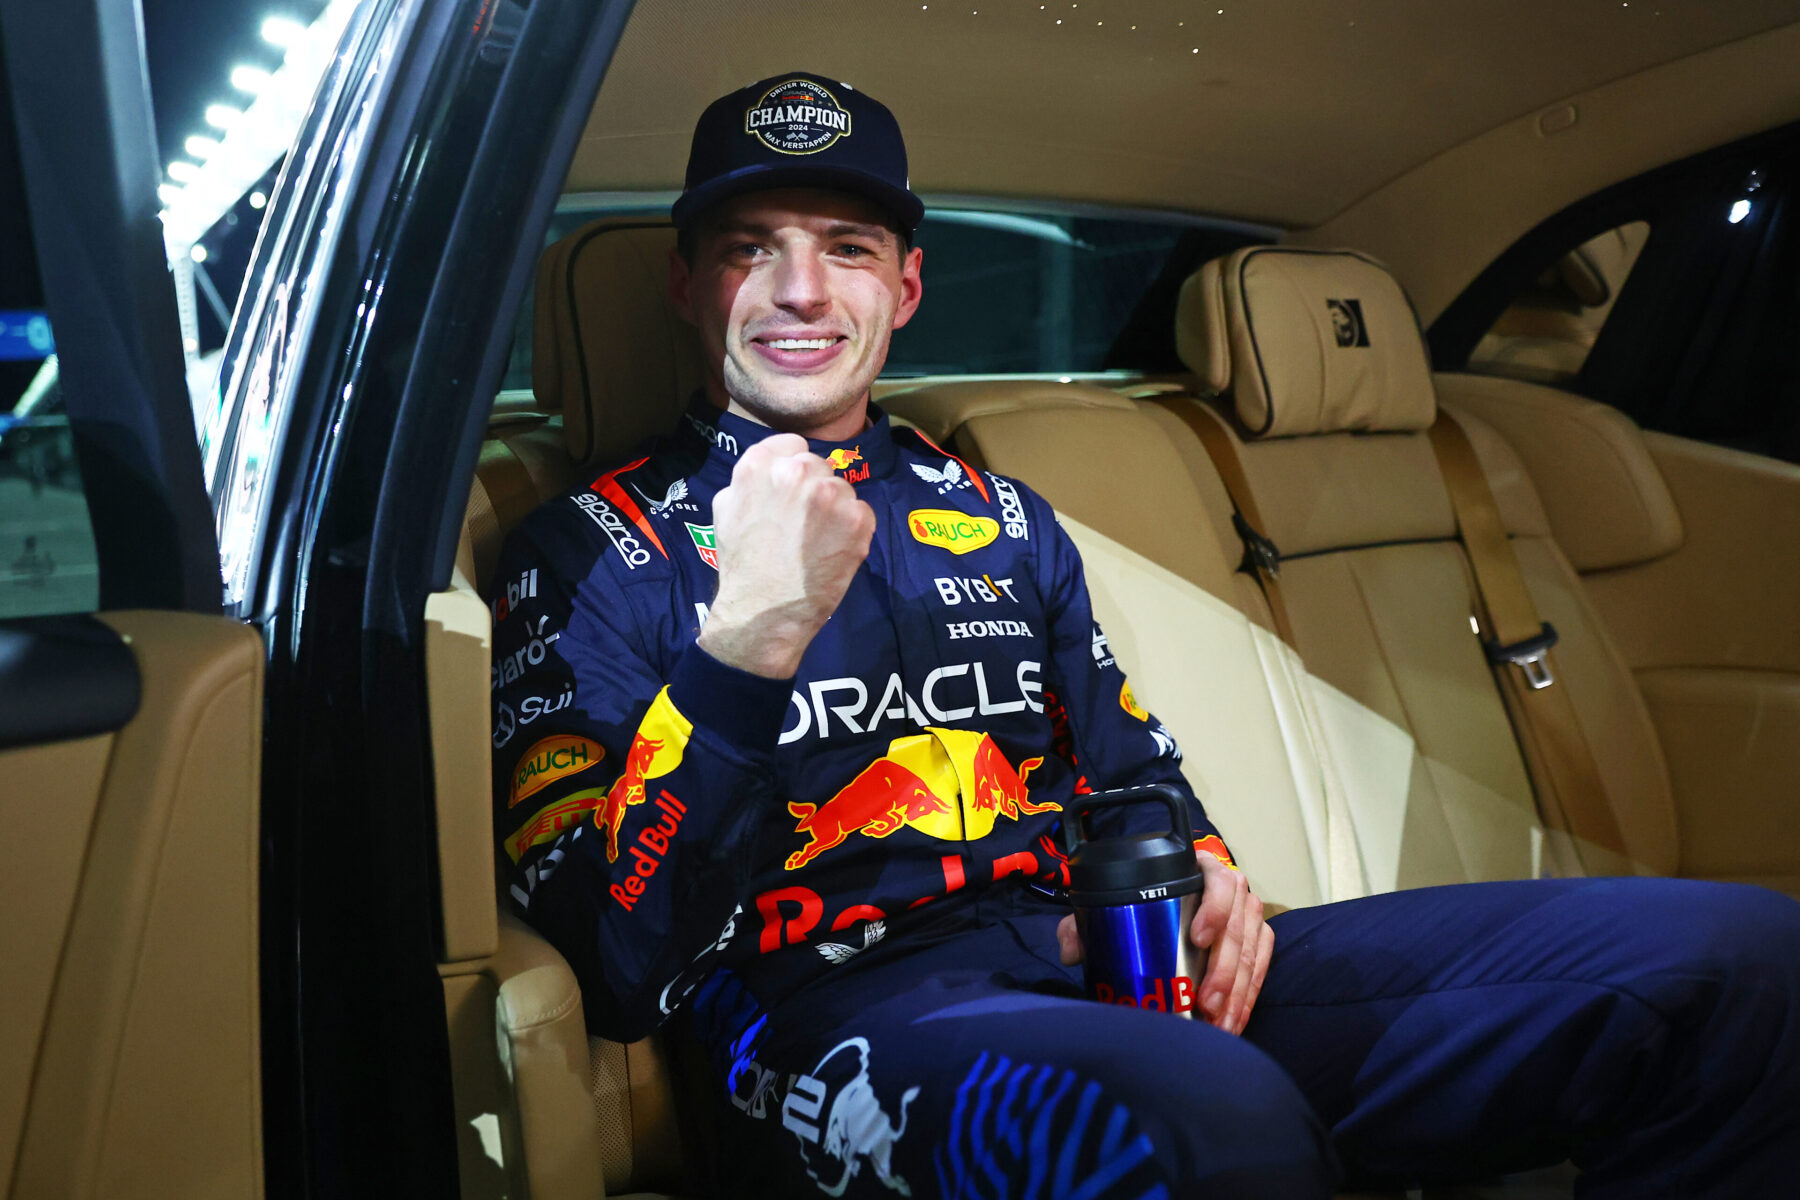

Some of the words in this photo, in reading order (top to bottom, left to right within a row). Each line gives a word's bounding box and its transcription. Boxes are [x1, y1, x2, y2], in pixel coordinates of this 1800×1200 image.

[769, 82, 798, 98] DRIVER
[800, 82, 828, 99] WORLD
[749, 105, 847, 131] CHAMPION
[764, 131, 781, 145] MAX
[782, 131, 832, 149] VERSTAPPEN
[649, 503, 699, 520] CSTORE
[984, 471, 1029, 541] sparc
[569, 493, 651, 570] sparco
[925, 521, 987, 541] RAUCH
[933, 574, 1019, 606] BYBIT
[946, 620, 1034, 640] HONDA
[518, 682, 573, 725] Sui
[517, 743, 589, 789] RAUCH
[609, 846, 660, 912] Red
[637, 789, 688, 857] Bull
[1139, 887, 1168, 900] YETI
